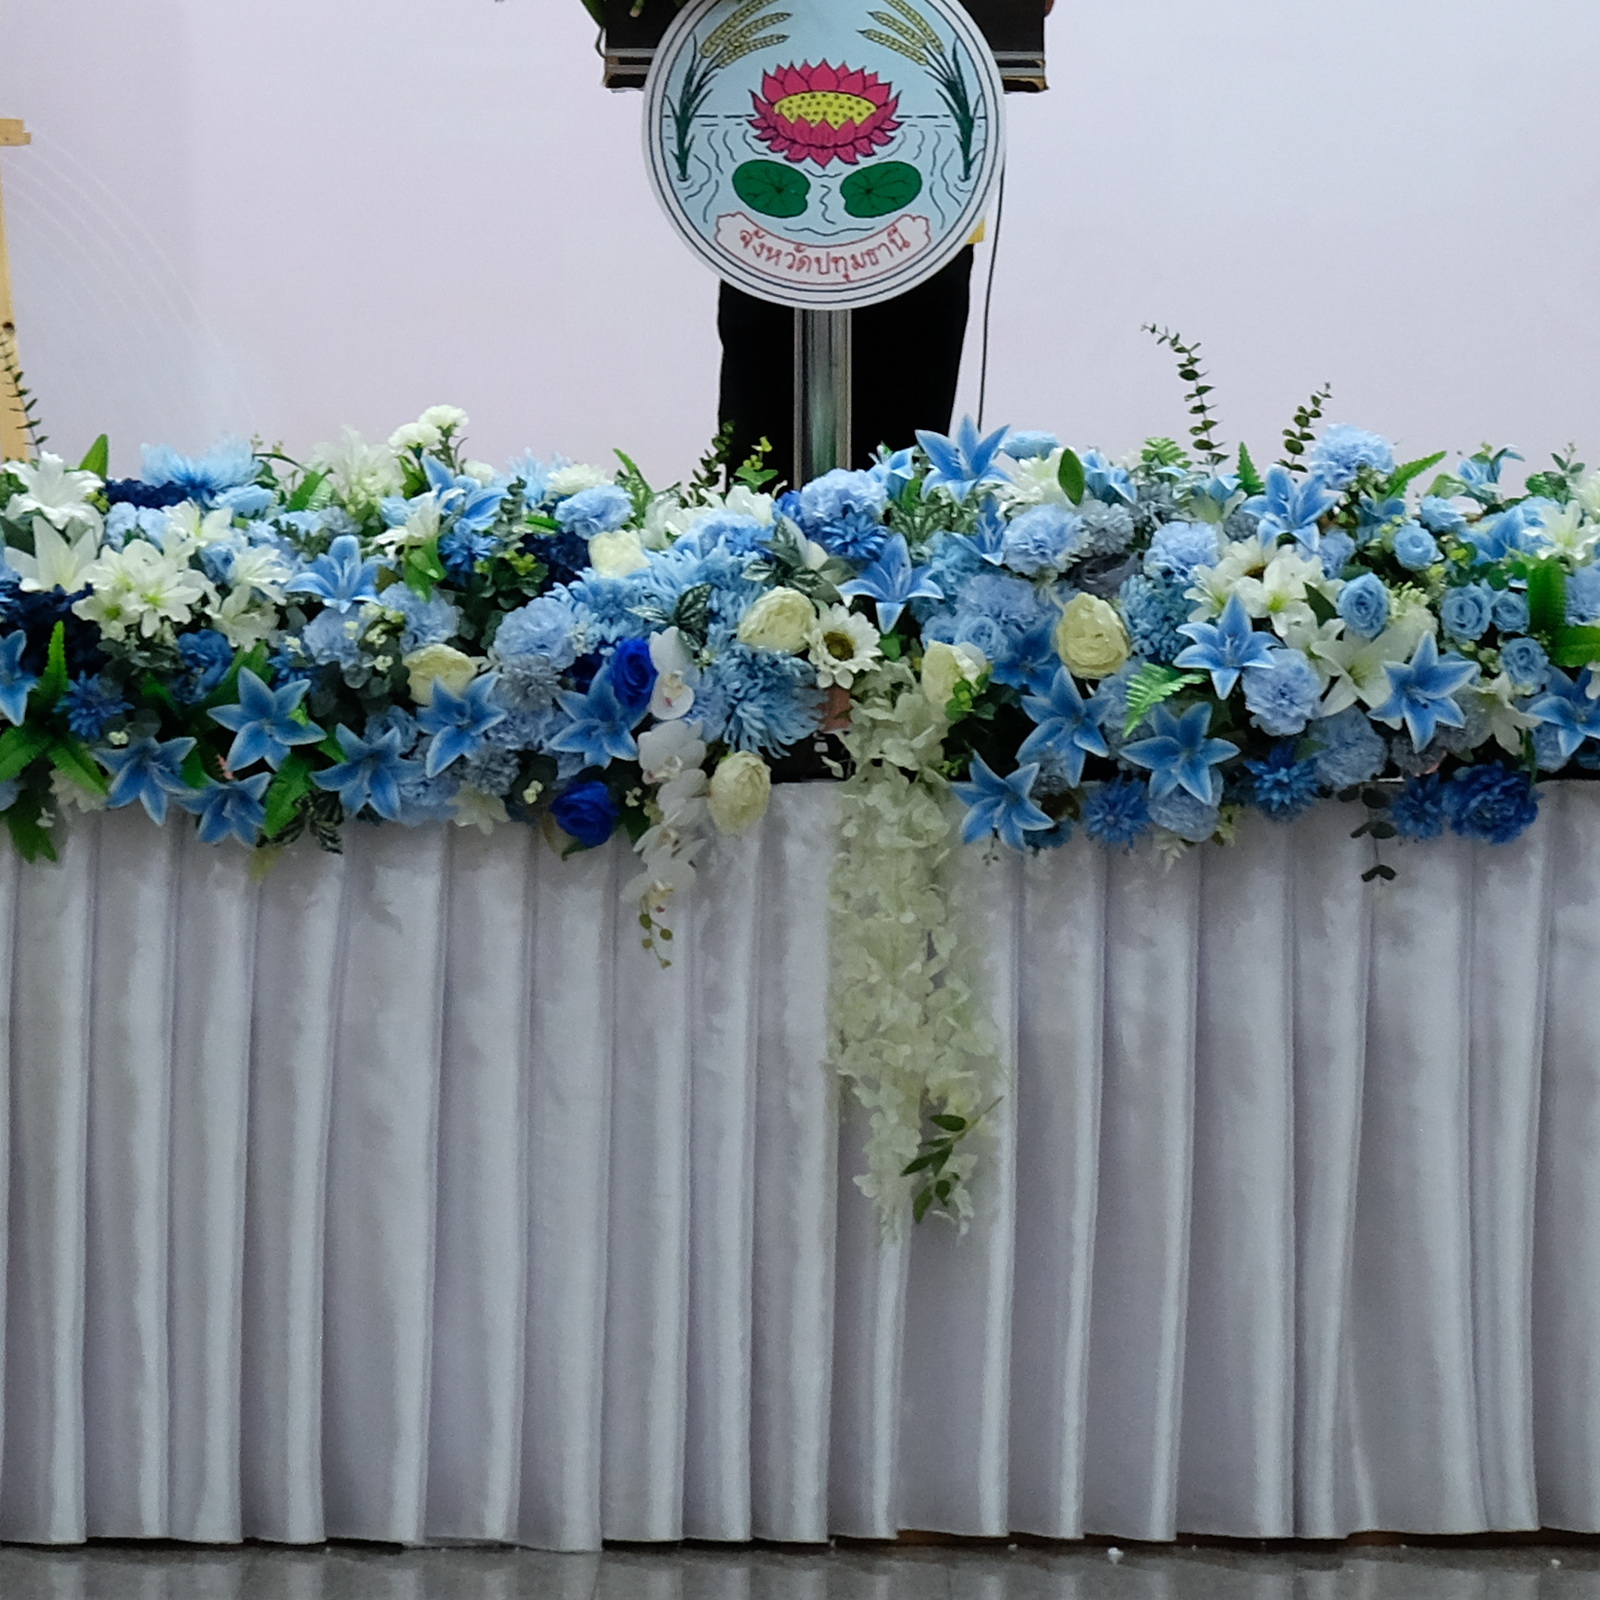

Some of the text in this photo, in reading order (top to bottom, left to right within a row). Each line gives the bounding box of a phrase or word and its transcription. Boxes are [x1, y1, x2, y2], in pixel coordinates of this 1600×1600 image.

[739, 226, 910, 282] จังหวัดปทุมธานี
